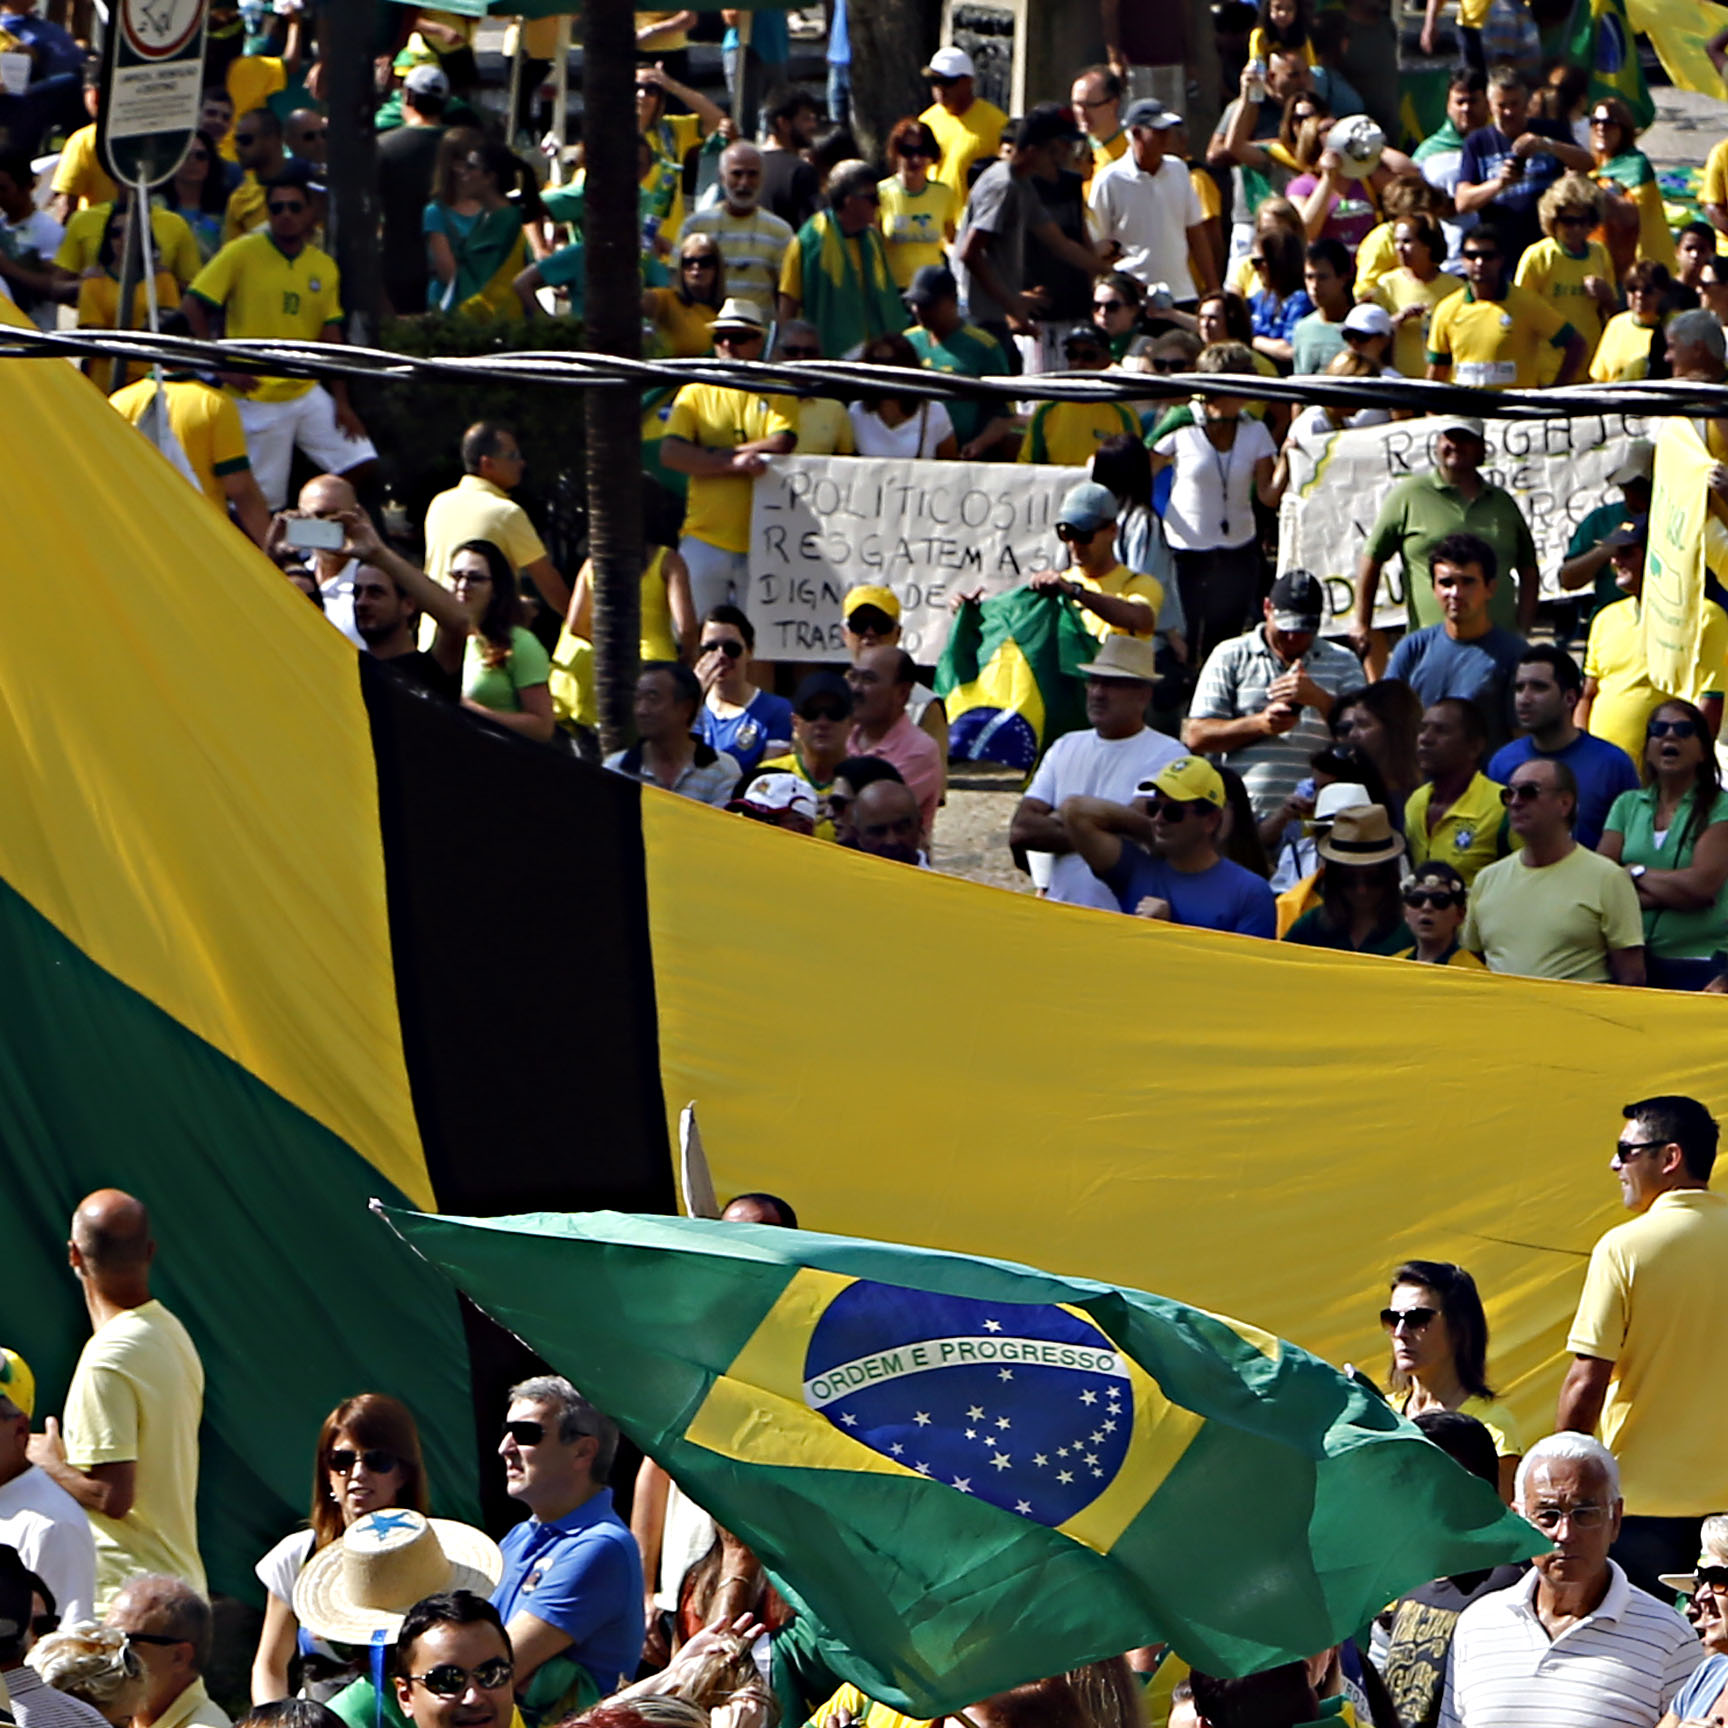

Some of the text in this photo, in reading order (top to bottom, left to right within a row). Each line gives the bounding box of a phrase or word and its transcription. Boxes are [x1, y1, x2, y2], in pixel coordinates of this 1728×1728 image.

[811, 1341, 1116, 1400] ORDEM E PROGRESSO
